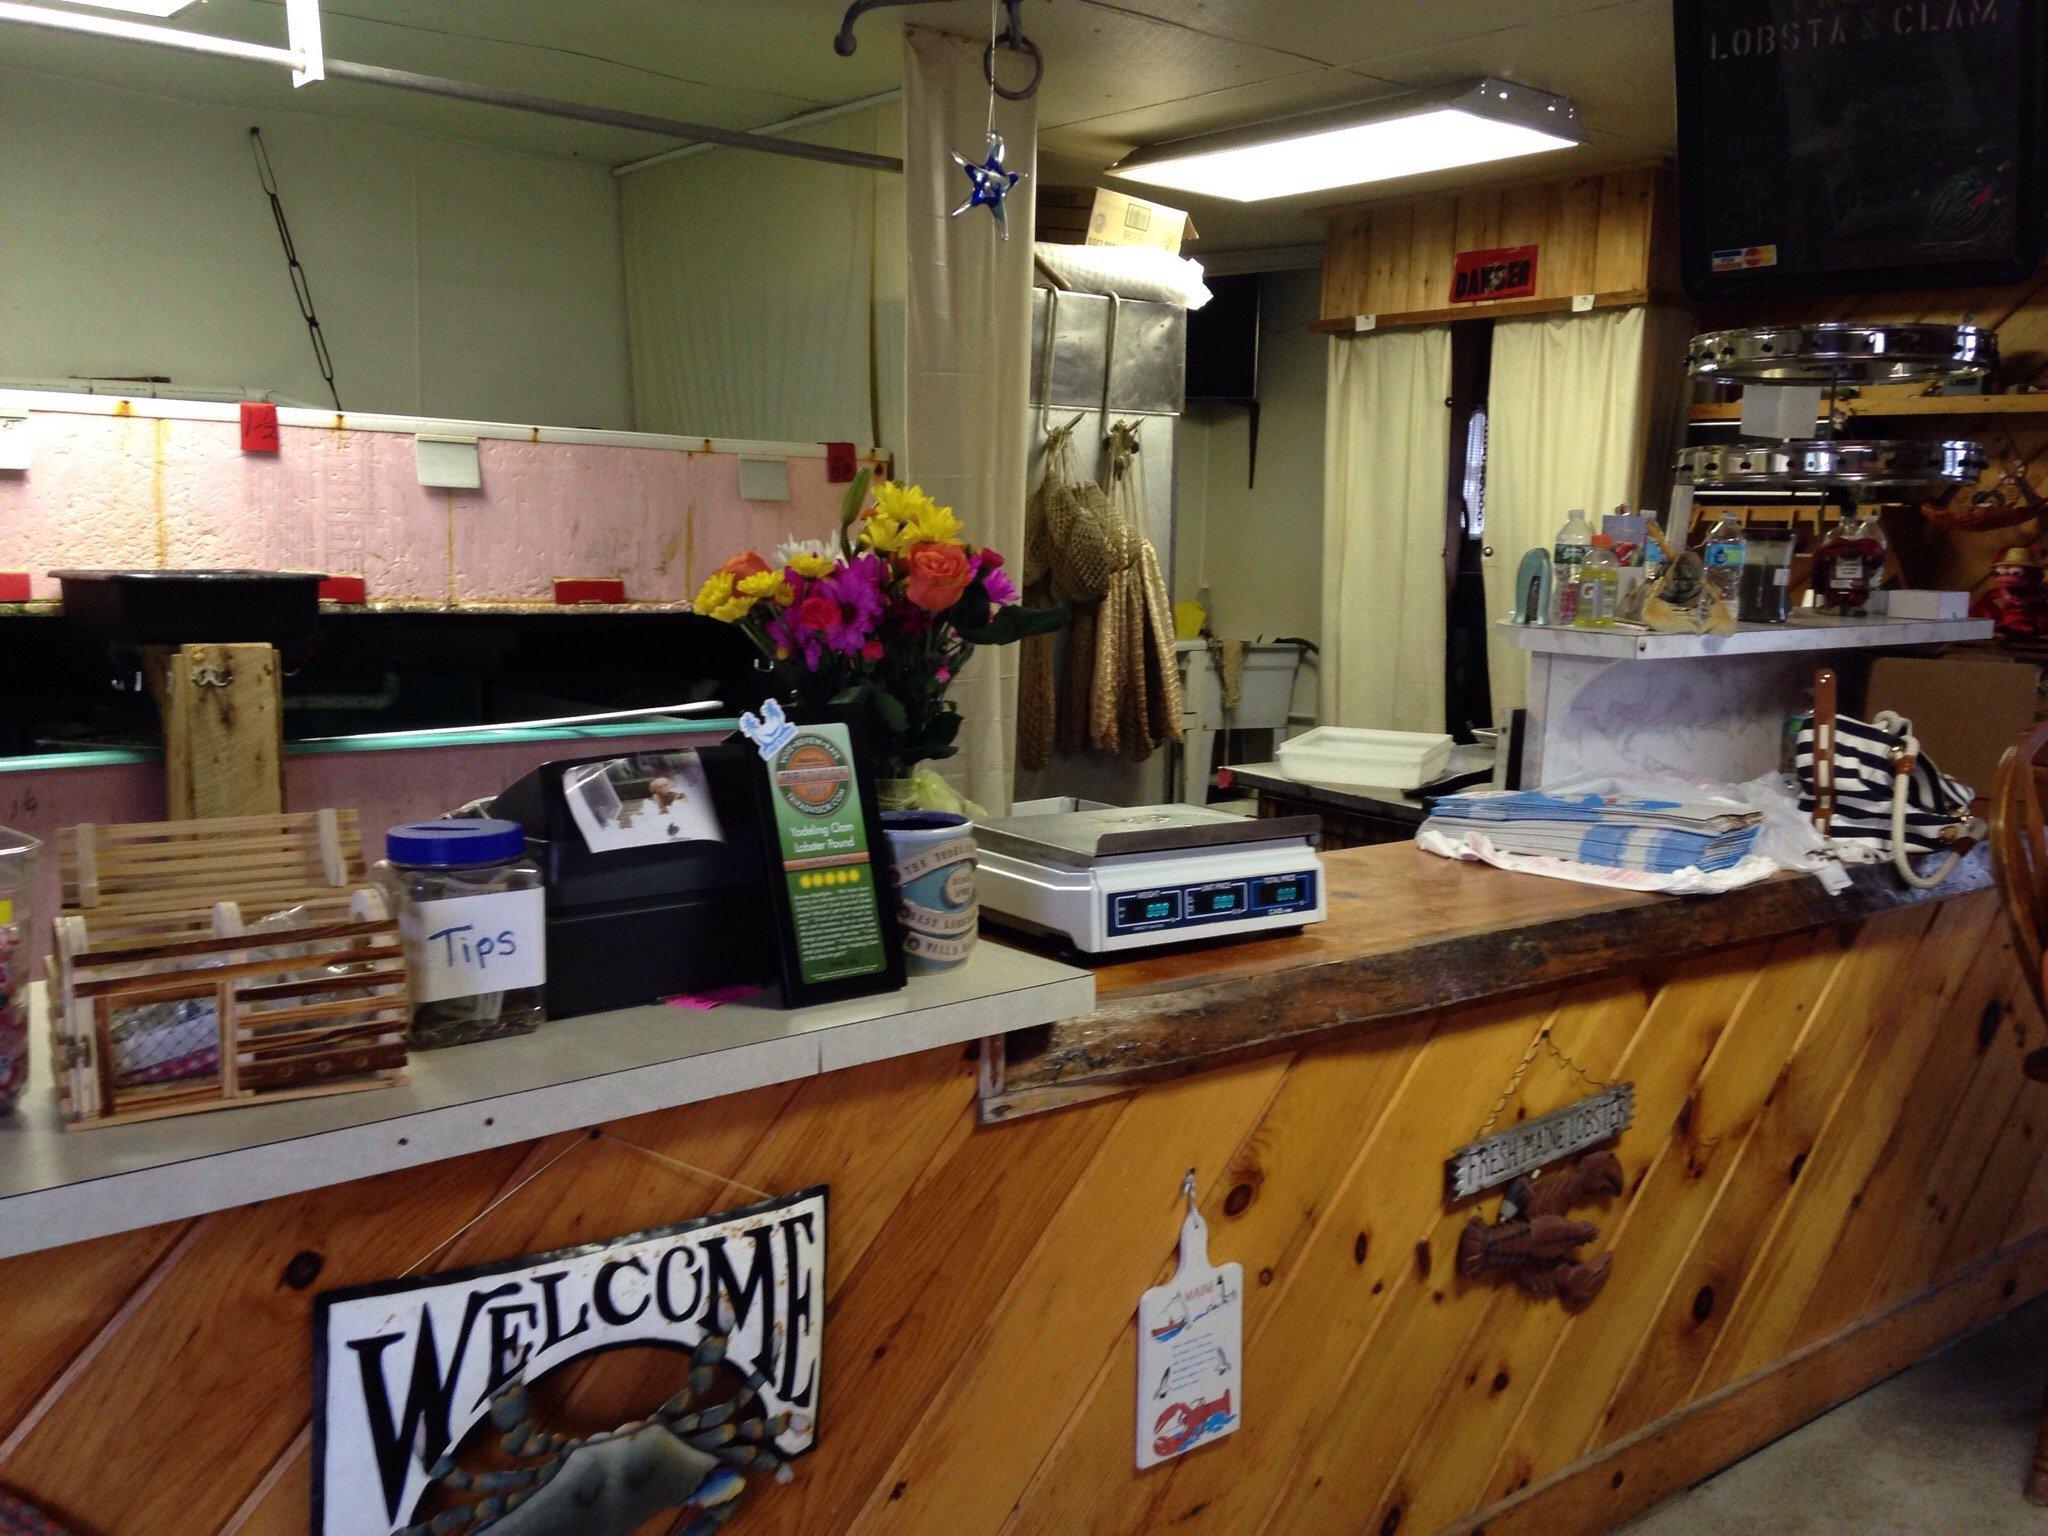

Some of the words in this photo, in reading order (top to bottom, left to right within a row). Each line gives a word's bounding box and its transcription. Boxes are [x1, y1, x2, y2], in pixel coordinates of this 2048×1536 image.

[1710, 17, 1846, 60] LOBSTA
[1895, 0, 1999, 34] CLAM
[429, 923, 518, 969] Tips
[345, 1211, 816, 1526] WELCOME
